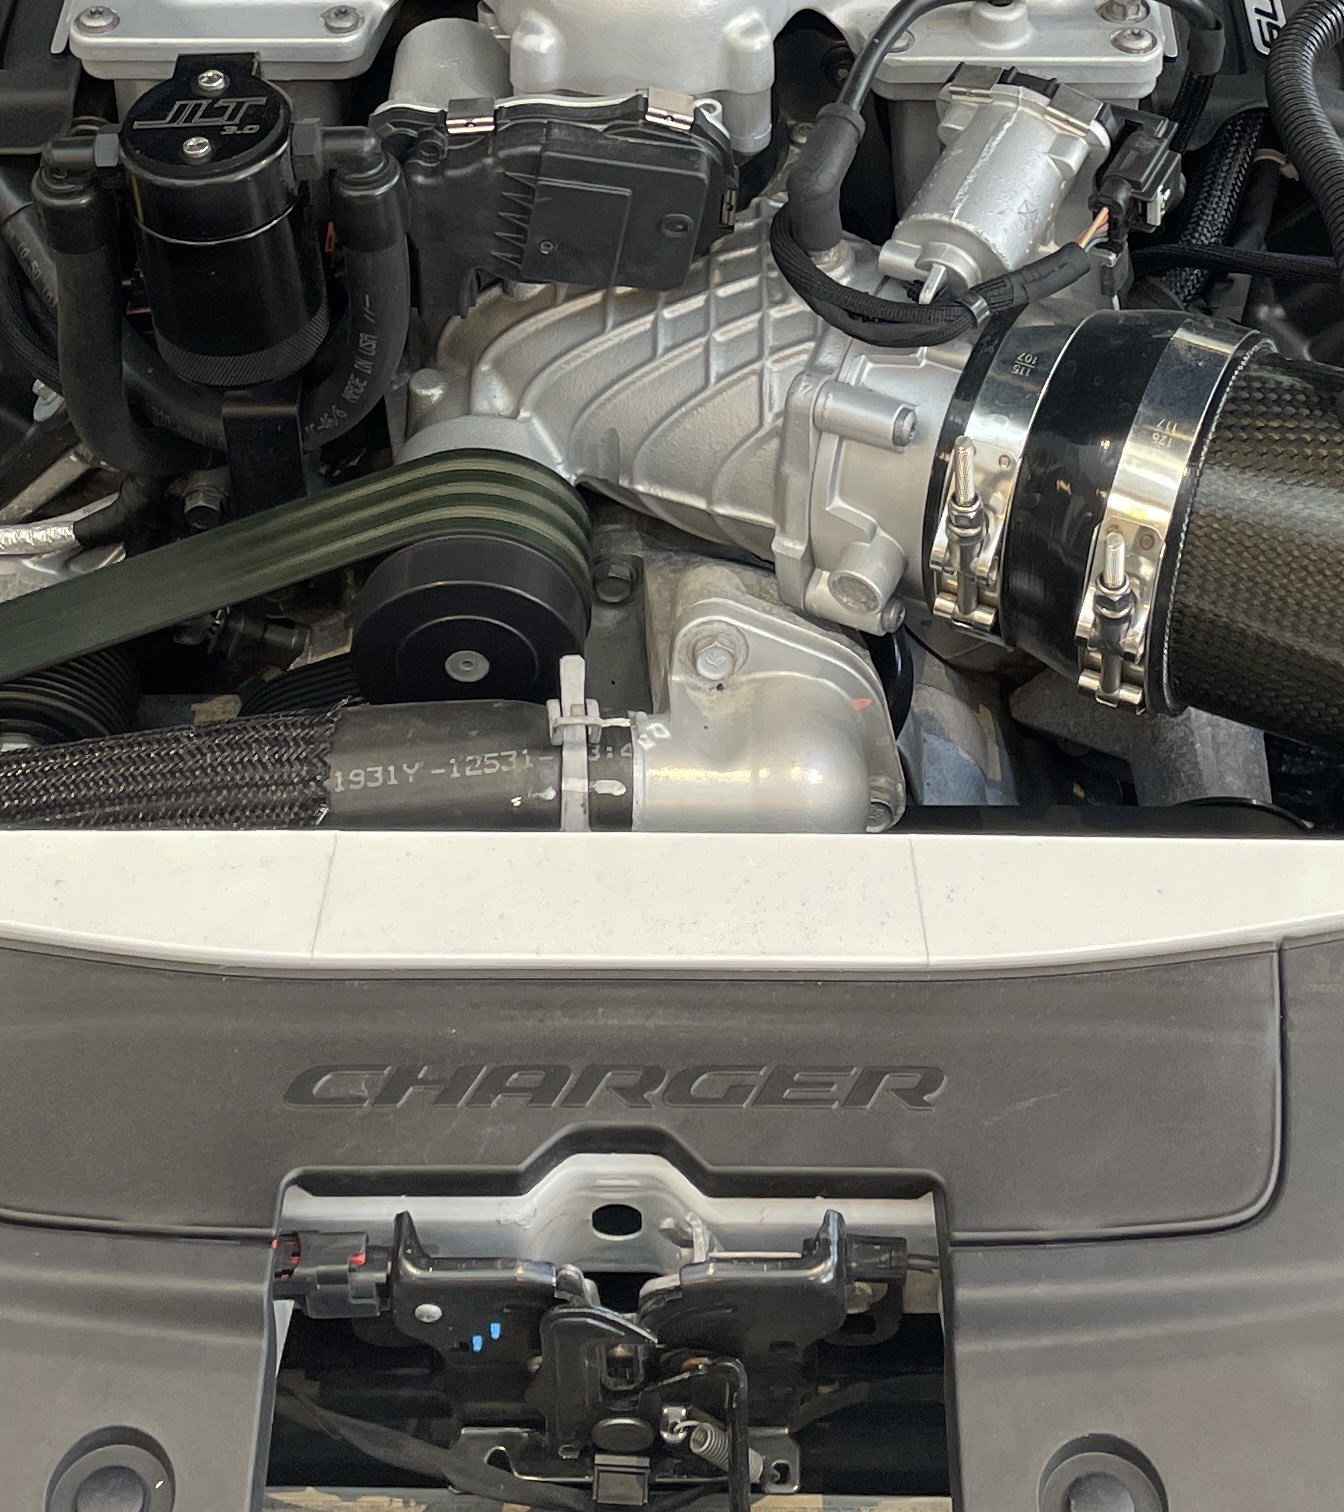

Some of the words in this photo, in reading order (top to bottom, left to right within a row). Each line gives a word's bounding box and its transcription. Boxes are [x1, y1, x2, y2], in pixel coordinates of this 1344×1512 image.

[133, 97, 267, 129] JLT
[358, 332, 378, 356] USA
[353, 358, 373, 375] IN
[1016, 352, 1038, 365] 107
[1156, 419, 1178, 435] 117
[284, 1065, 949, 1111] CHARGER
